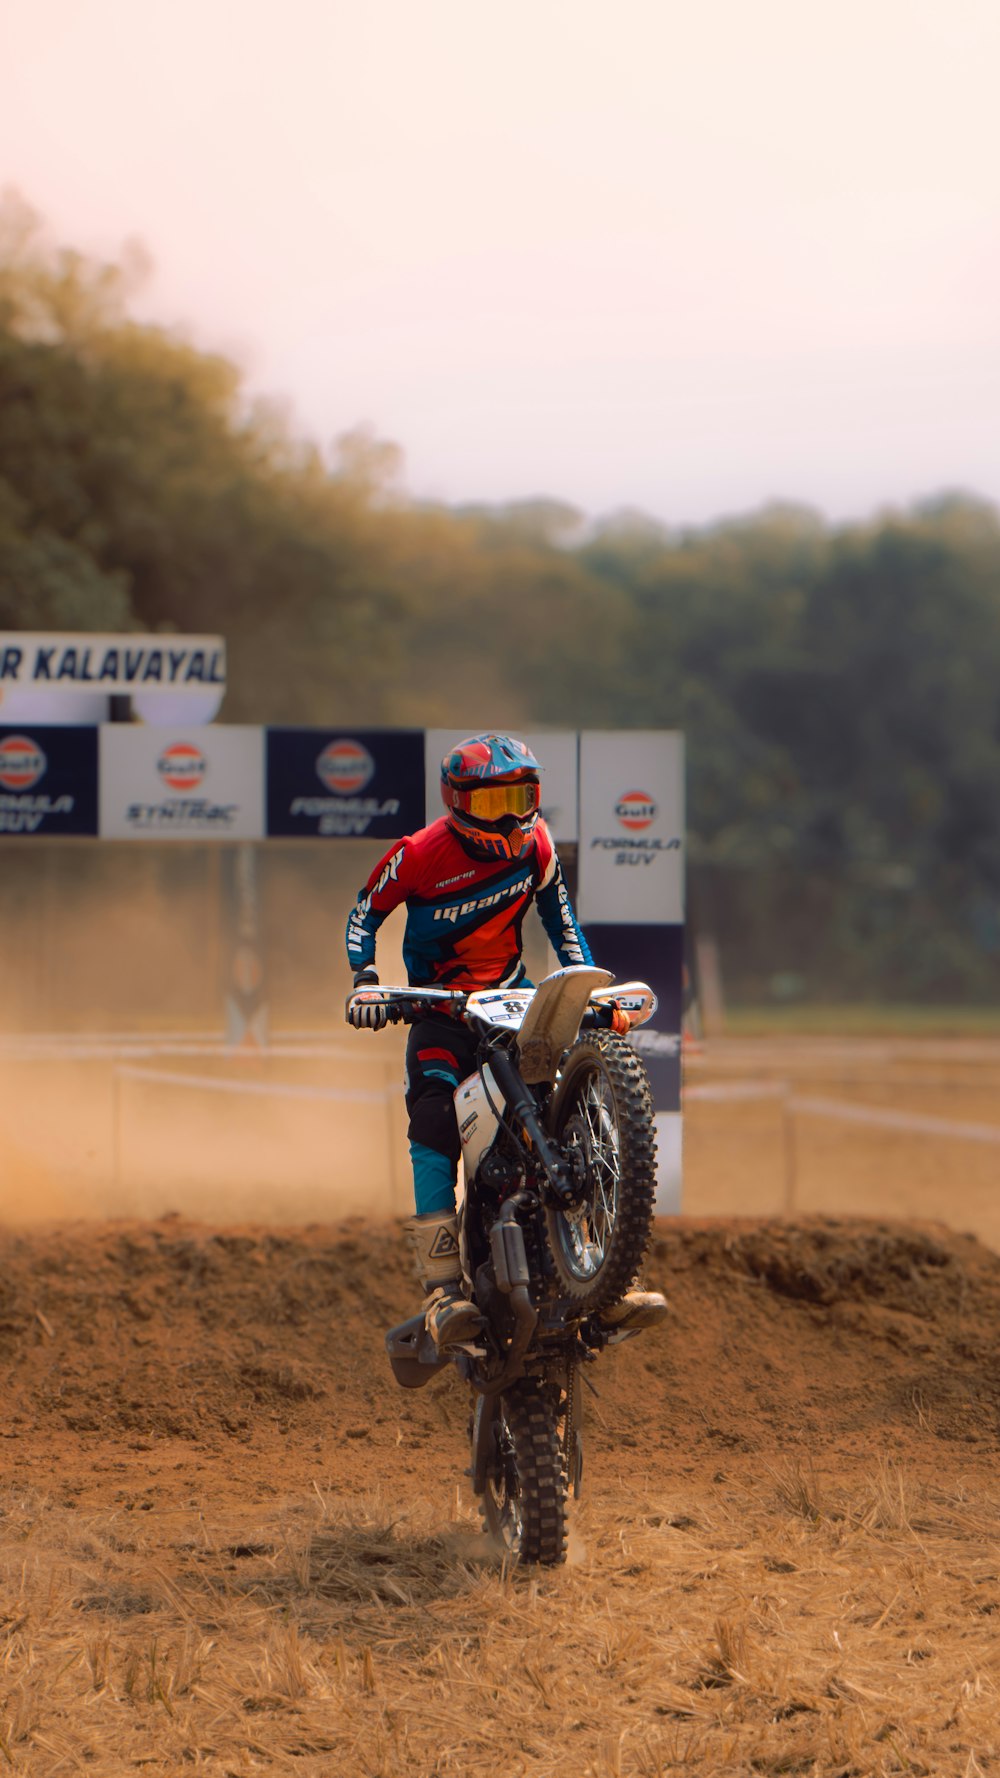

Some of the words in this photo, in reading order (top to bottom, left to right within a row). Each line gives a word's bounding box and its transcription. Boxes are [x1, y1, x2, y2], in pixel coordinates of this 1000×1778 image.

[33, 647, 225, 683] KALAVAYAL
[290, 797, 400, 816] FORMULA
[615, 803, 655, 817] Gulf
[318, 815, 371, 834] SUV
[590, 837, 681, 850] FORMULA
[614, 851, 656, 866] SUV
